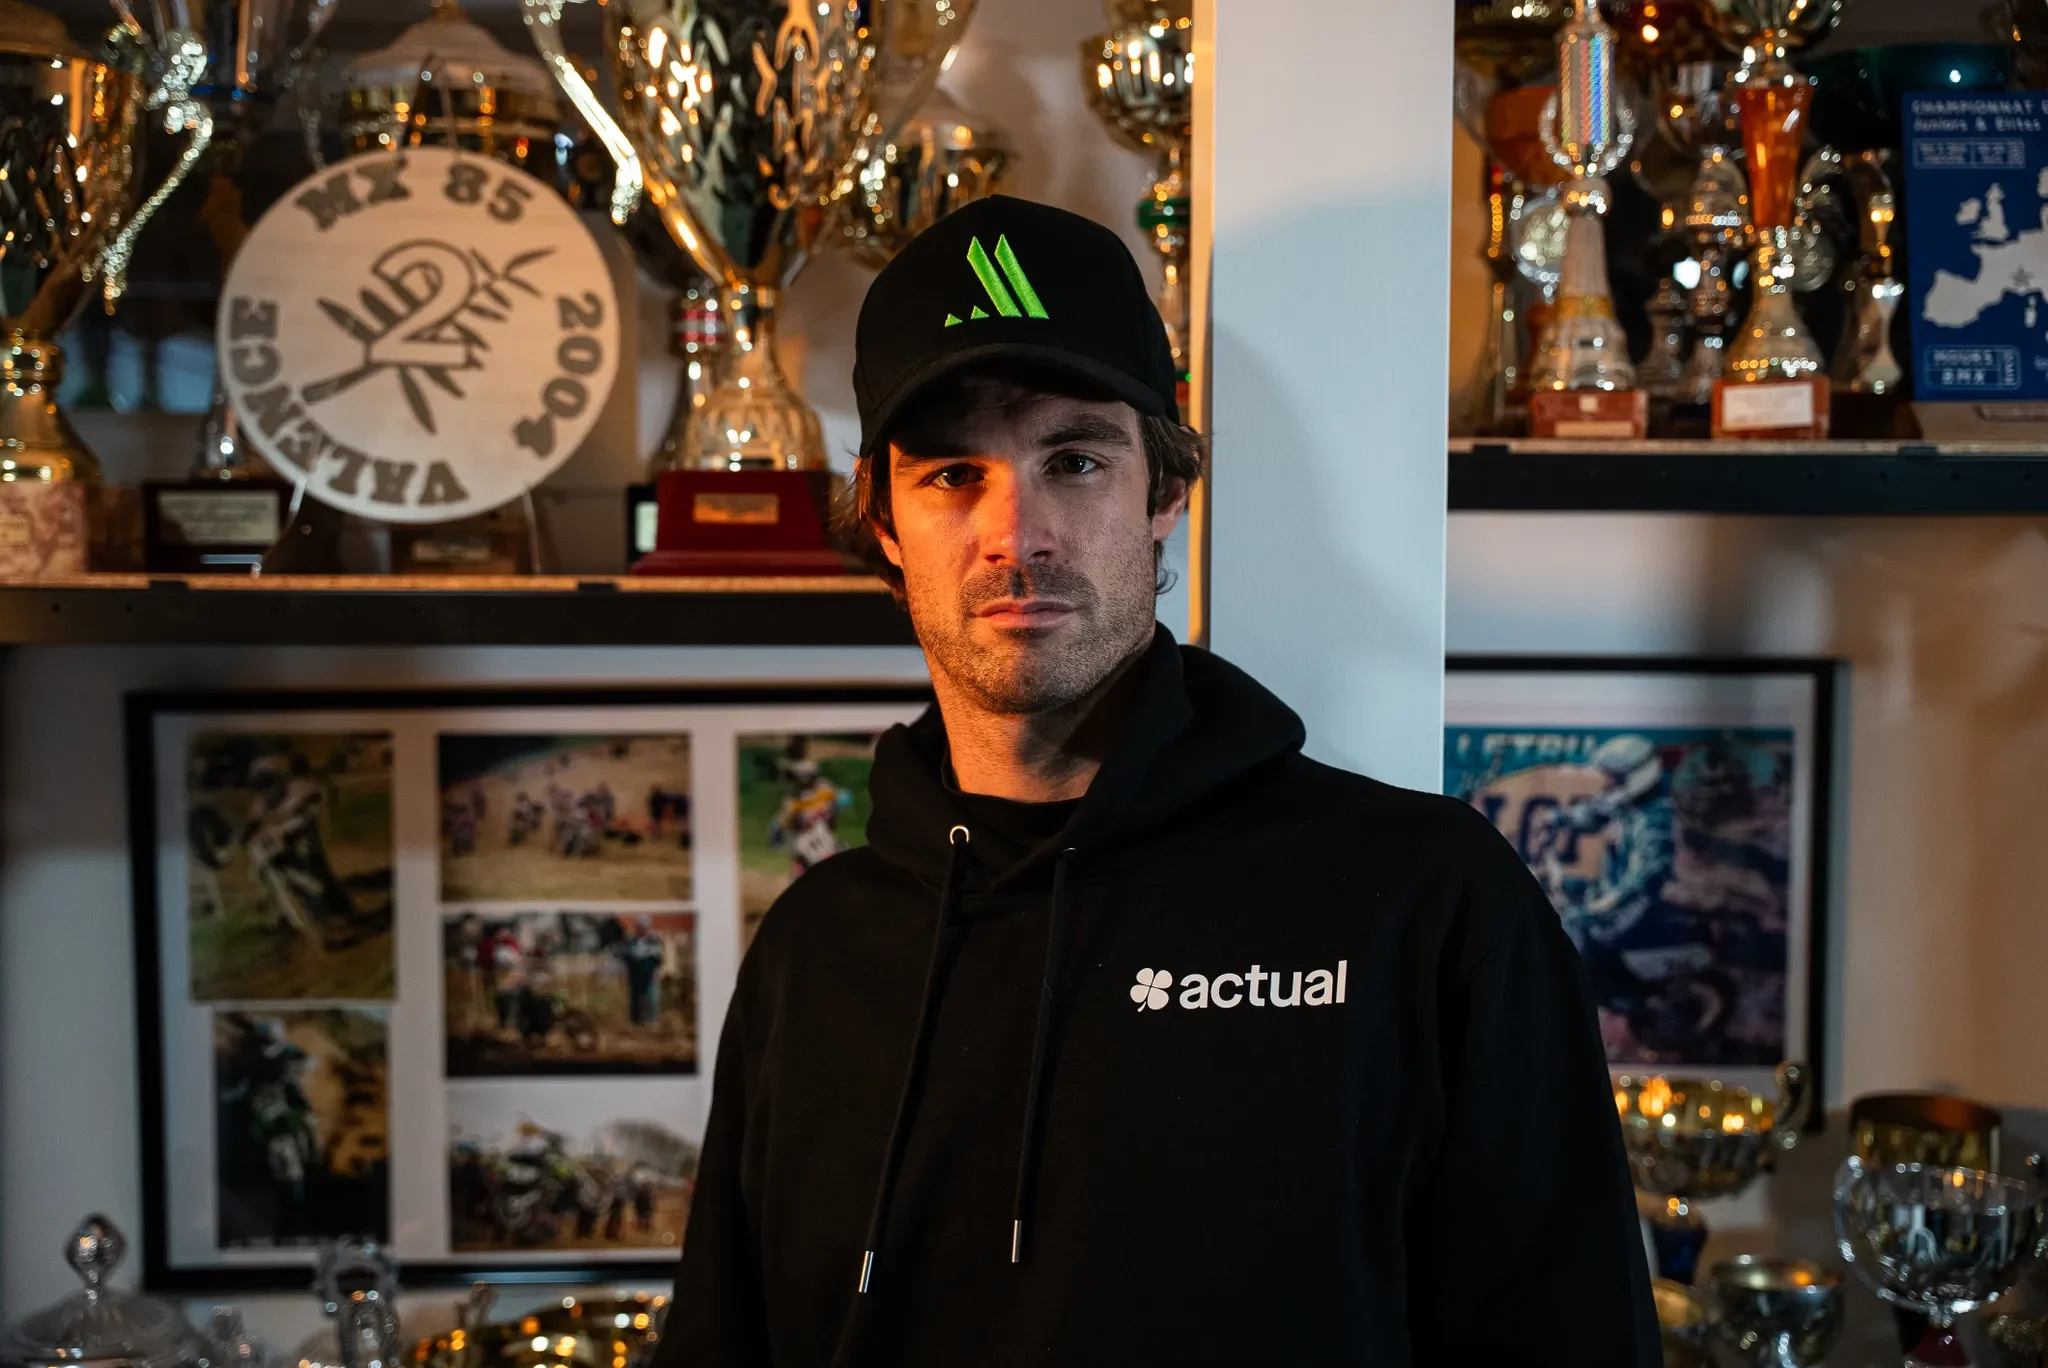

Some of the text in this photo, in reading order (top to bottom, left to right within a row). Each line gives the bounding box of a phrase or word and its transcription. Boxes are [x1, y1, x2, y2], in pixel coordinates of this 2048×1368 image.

[296, 158, 534, 233] MX 85
[229, 295, 471, 508] VALENCE
[511, 290, 606, 461] 2004
[1179, 959, 1348, 1010] actual
